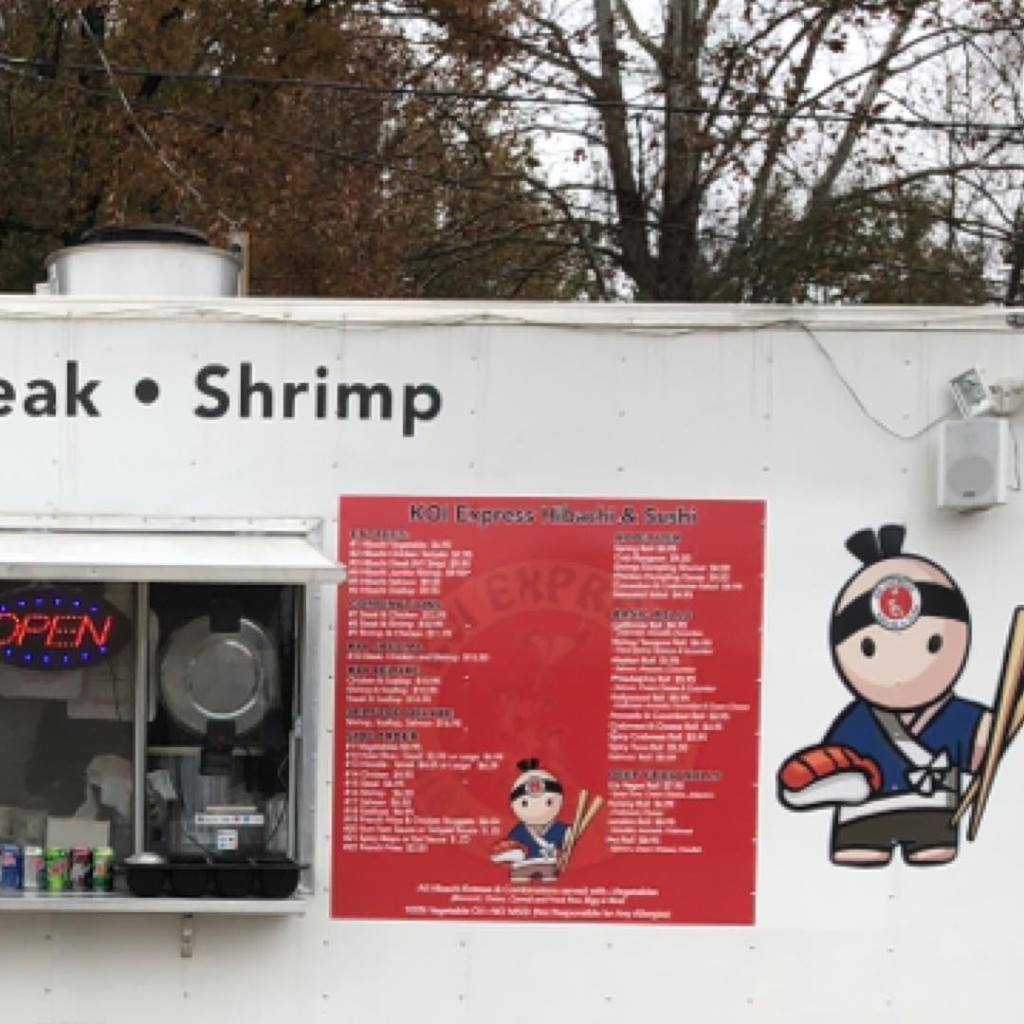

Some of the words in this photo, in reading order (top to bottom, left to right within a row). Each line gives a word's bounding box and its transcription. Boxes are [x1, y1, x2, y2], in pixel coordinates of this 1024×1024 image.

[194, 362, 441, 438] Shrimp
[410, 504, 448, 522] KOI
[456, 504, 534, 528] Express
[620, 507, 637, 525] &
[644, 506, 697, 525] Sushi
